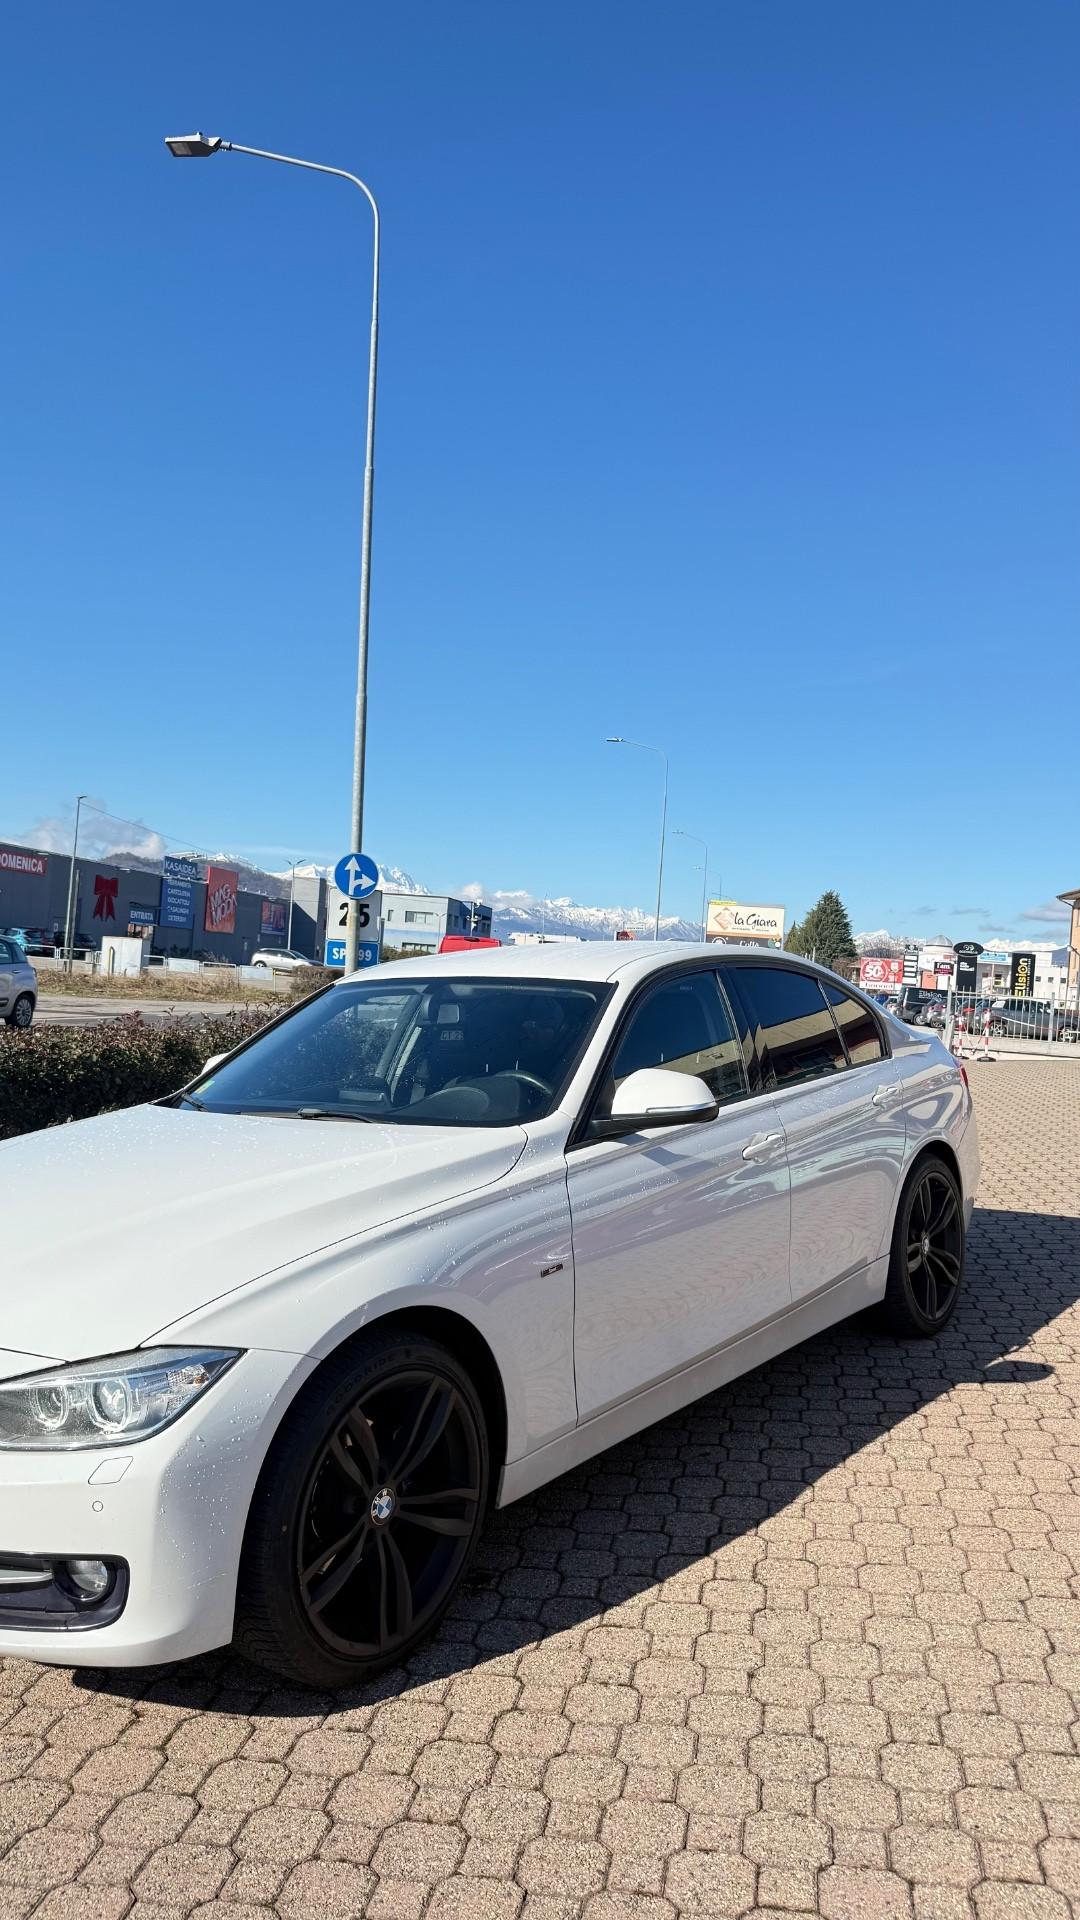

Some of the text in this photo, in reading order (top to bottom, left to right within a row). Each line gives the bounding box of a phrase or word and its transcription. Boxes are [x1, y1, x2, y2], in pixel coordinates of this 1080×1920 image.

[0, 852, 43, 873] OMENICA
[165, 860, 197, 876] KASAIDEA
[130, 910, 154, 921] ENTRATA
[746, 913, 777, 930] Giara
